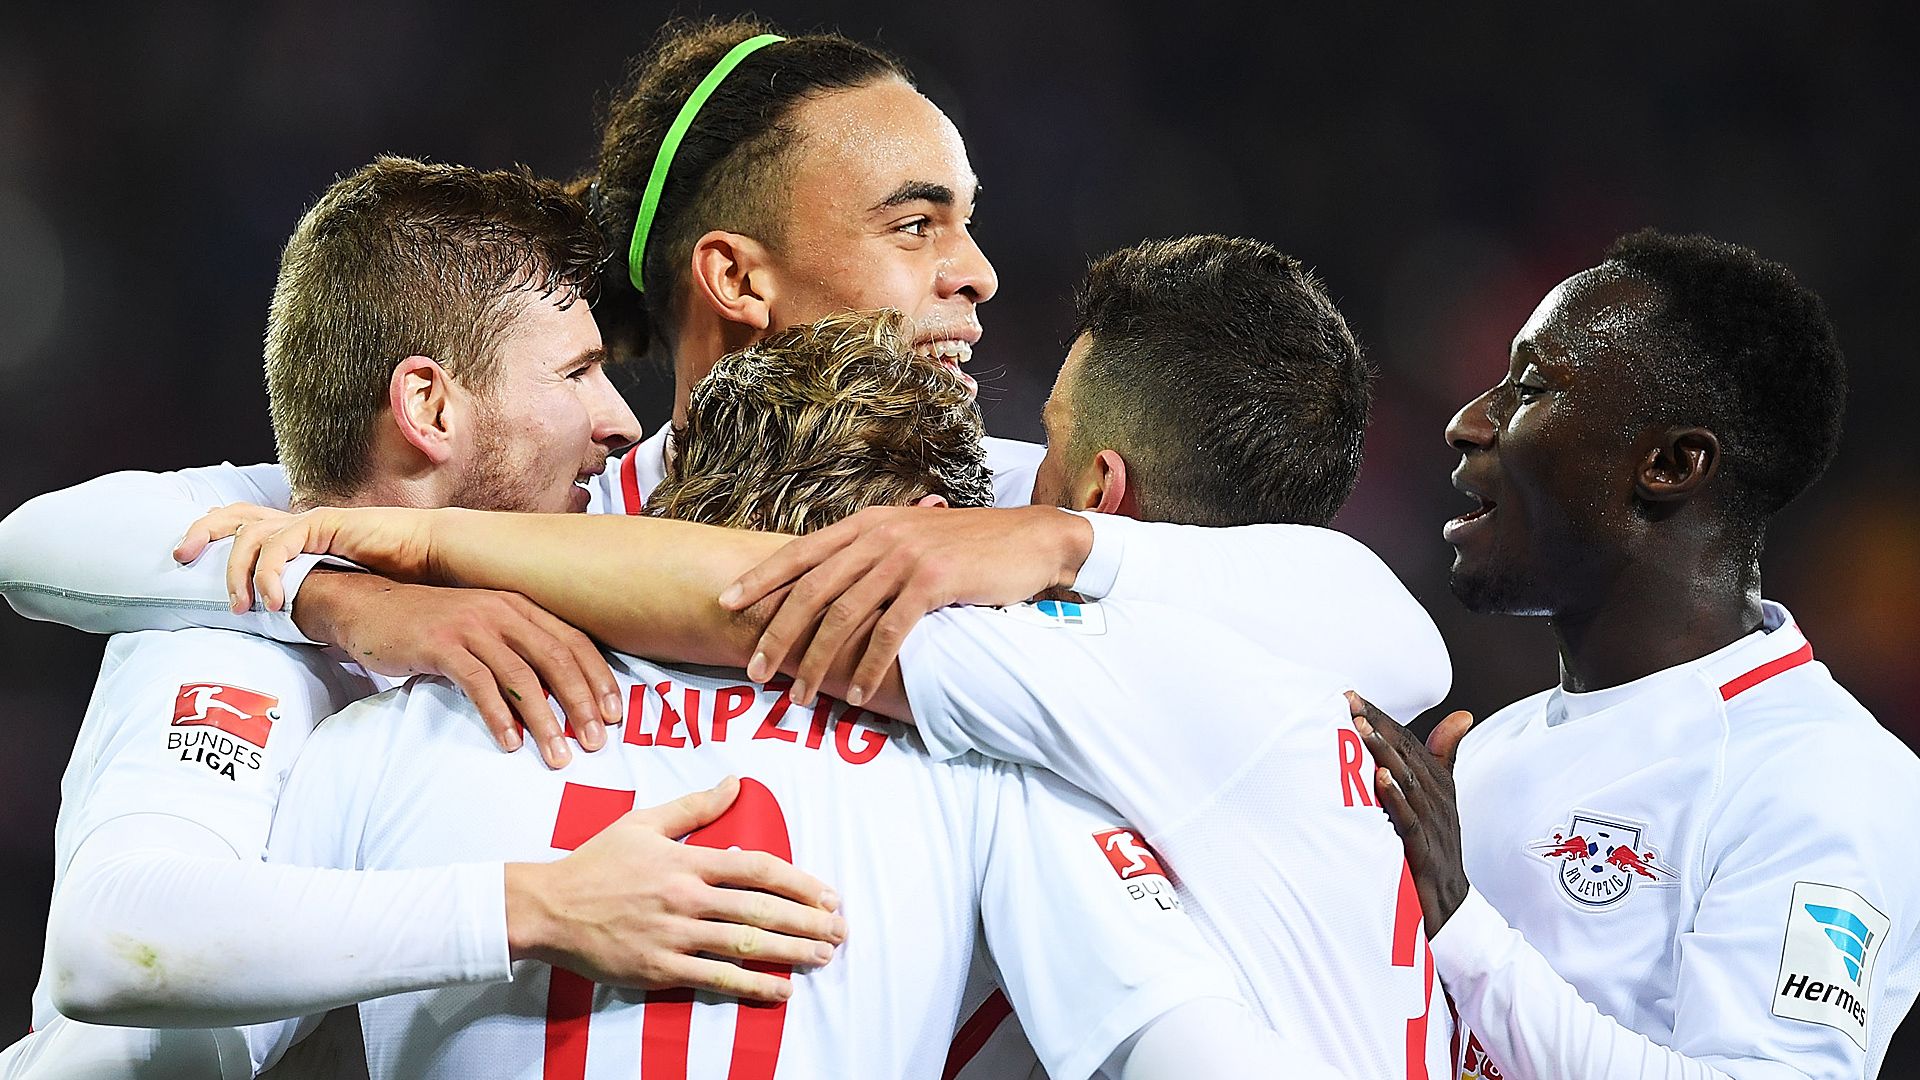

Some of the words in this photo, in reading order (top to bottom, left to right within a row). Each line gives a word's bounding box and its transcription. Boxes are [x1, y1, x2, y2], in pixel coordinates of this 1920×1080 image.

[623, 681, 889, 764] LEIPZIG
[168, 731, 262, 770] BUNDES
[180, 747, 236, 781] LIGA
[1337, 728, 1384, 808] R
[1565, 867, 1581, 884] RB
[1577, 874, 1624, 897] LEIPZIG
[1781, 973, 1866, 1028] Hermes
